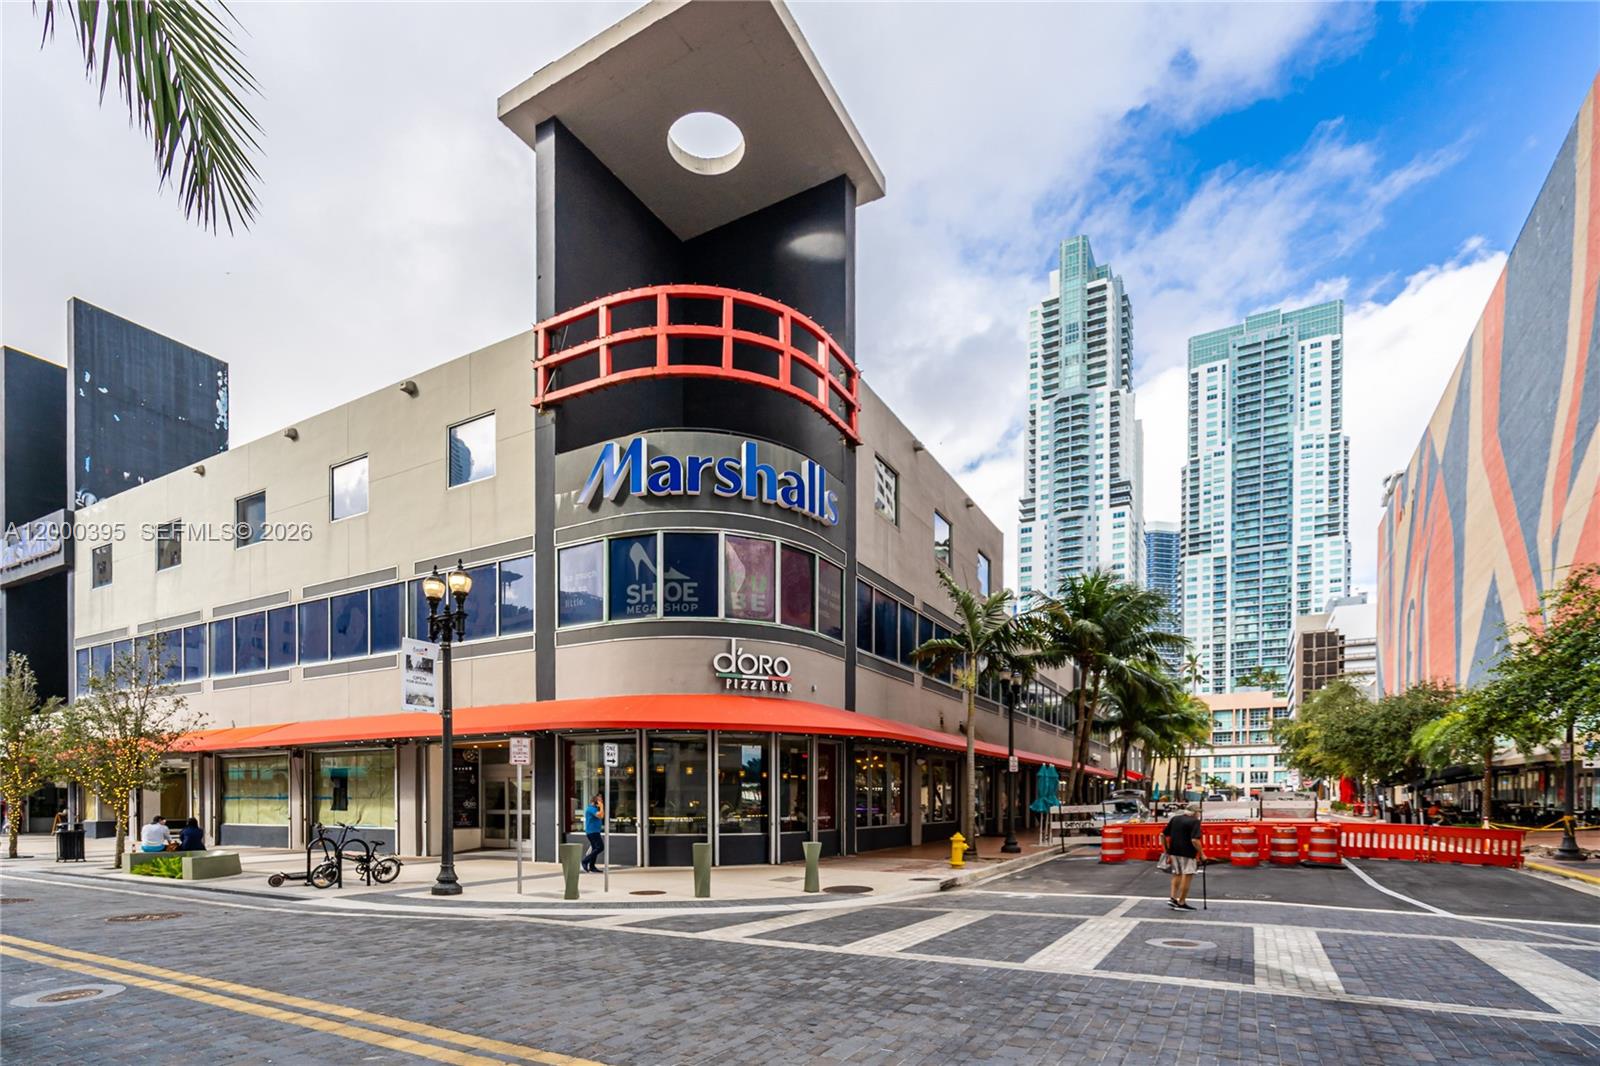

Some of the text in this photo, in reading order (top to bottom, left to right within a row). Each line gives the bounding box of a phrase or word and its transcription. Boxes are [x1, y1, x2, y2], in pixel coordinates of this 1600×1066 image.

[577, 436, 839, 526] Marshalls
[626, 581, 699, 604] SHOE
[626, 603, 698, 615] MEGA SHOP
[726, 679, 793, 693] PIZZA BAR
